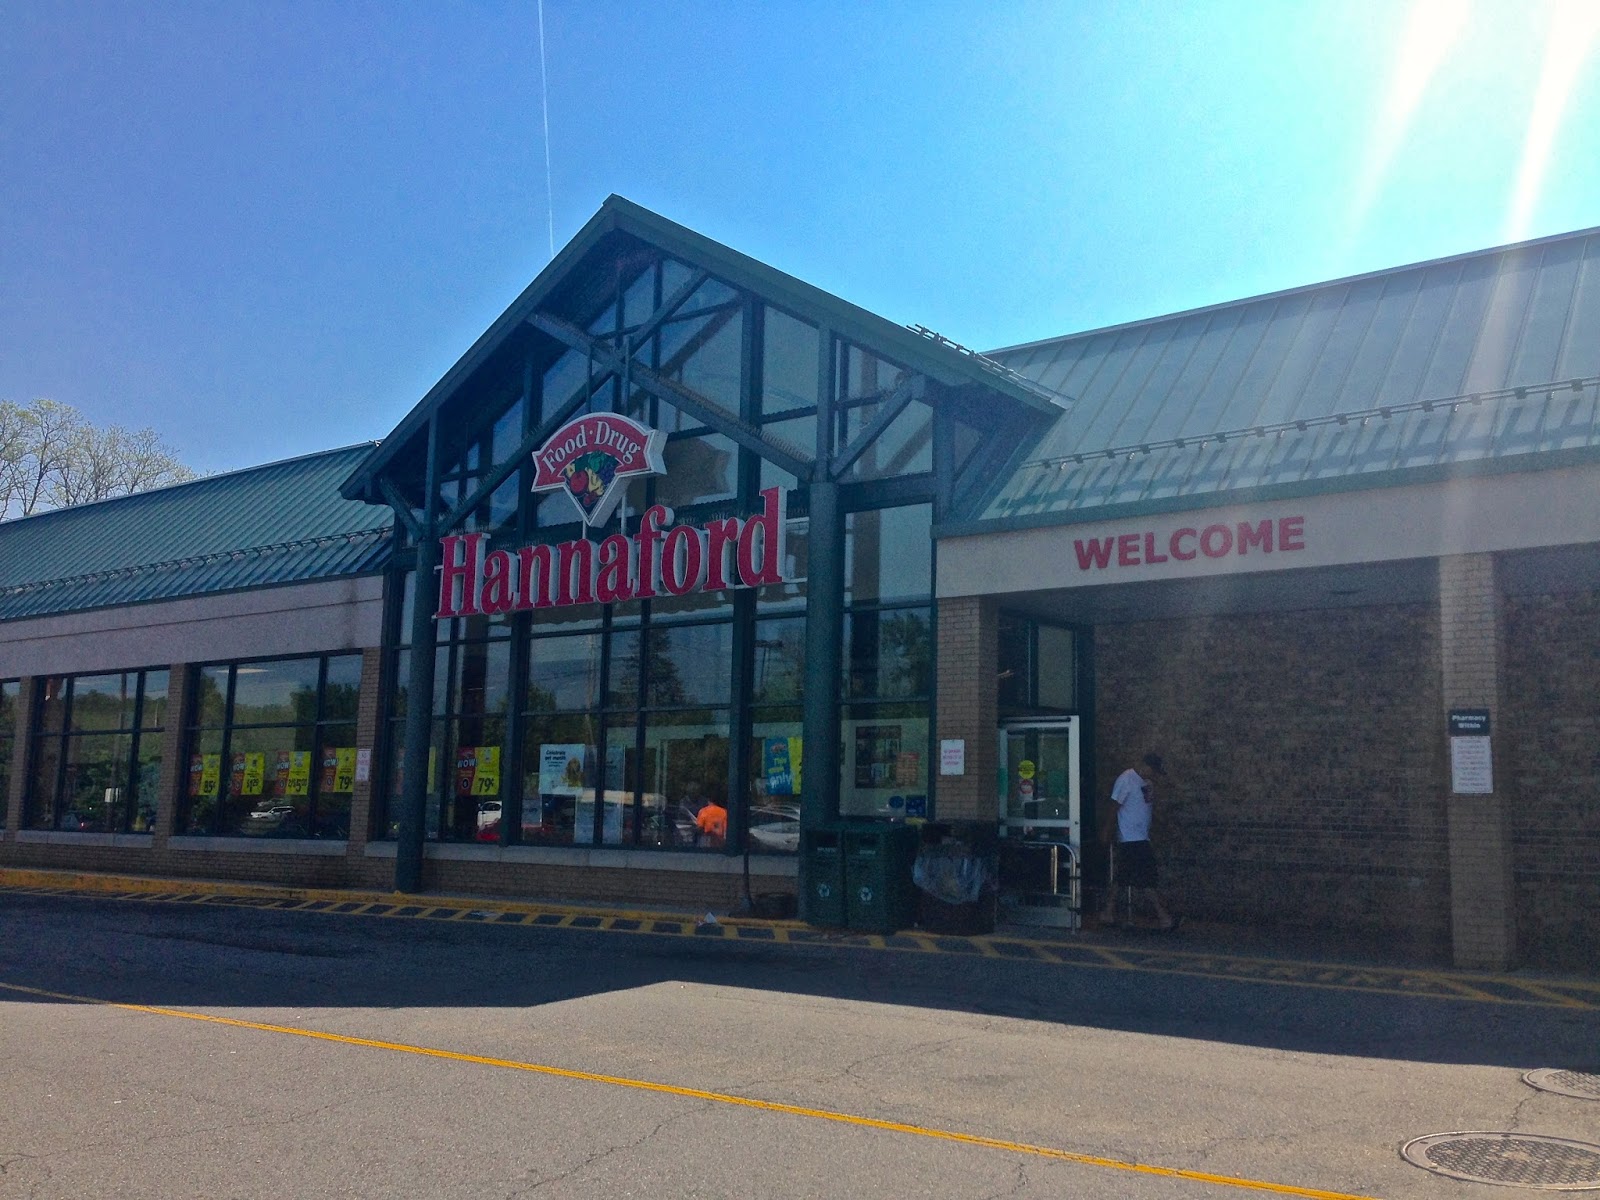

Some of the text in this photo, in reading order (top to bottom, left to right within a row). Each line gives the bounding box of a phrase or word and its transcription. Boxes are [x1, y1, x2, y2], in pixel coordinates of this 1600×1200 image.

[542, 421, 641, 474] Food Drug
[435, 486, 783, 618] Hannaford
[1073, 516, 1305, 570] WELCOME
[478, 777, 494, 792] 79¢
